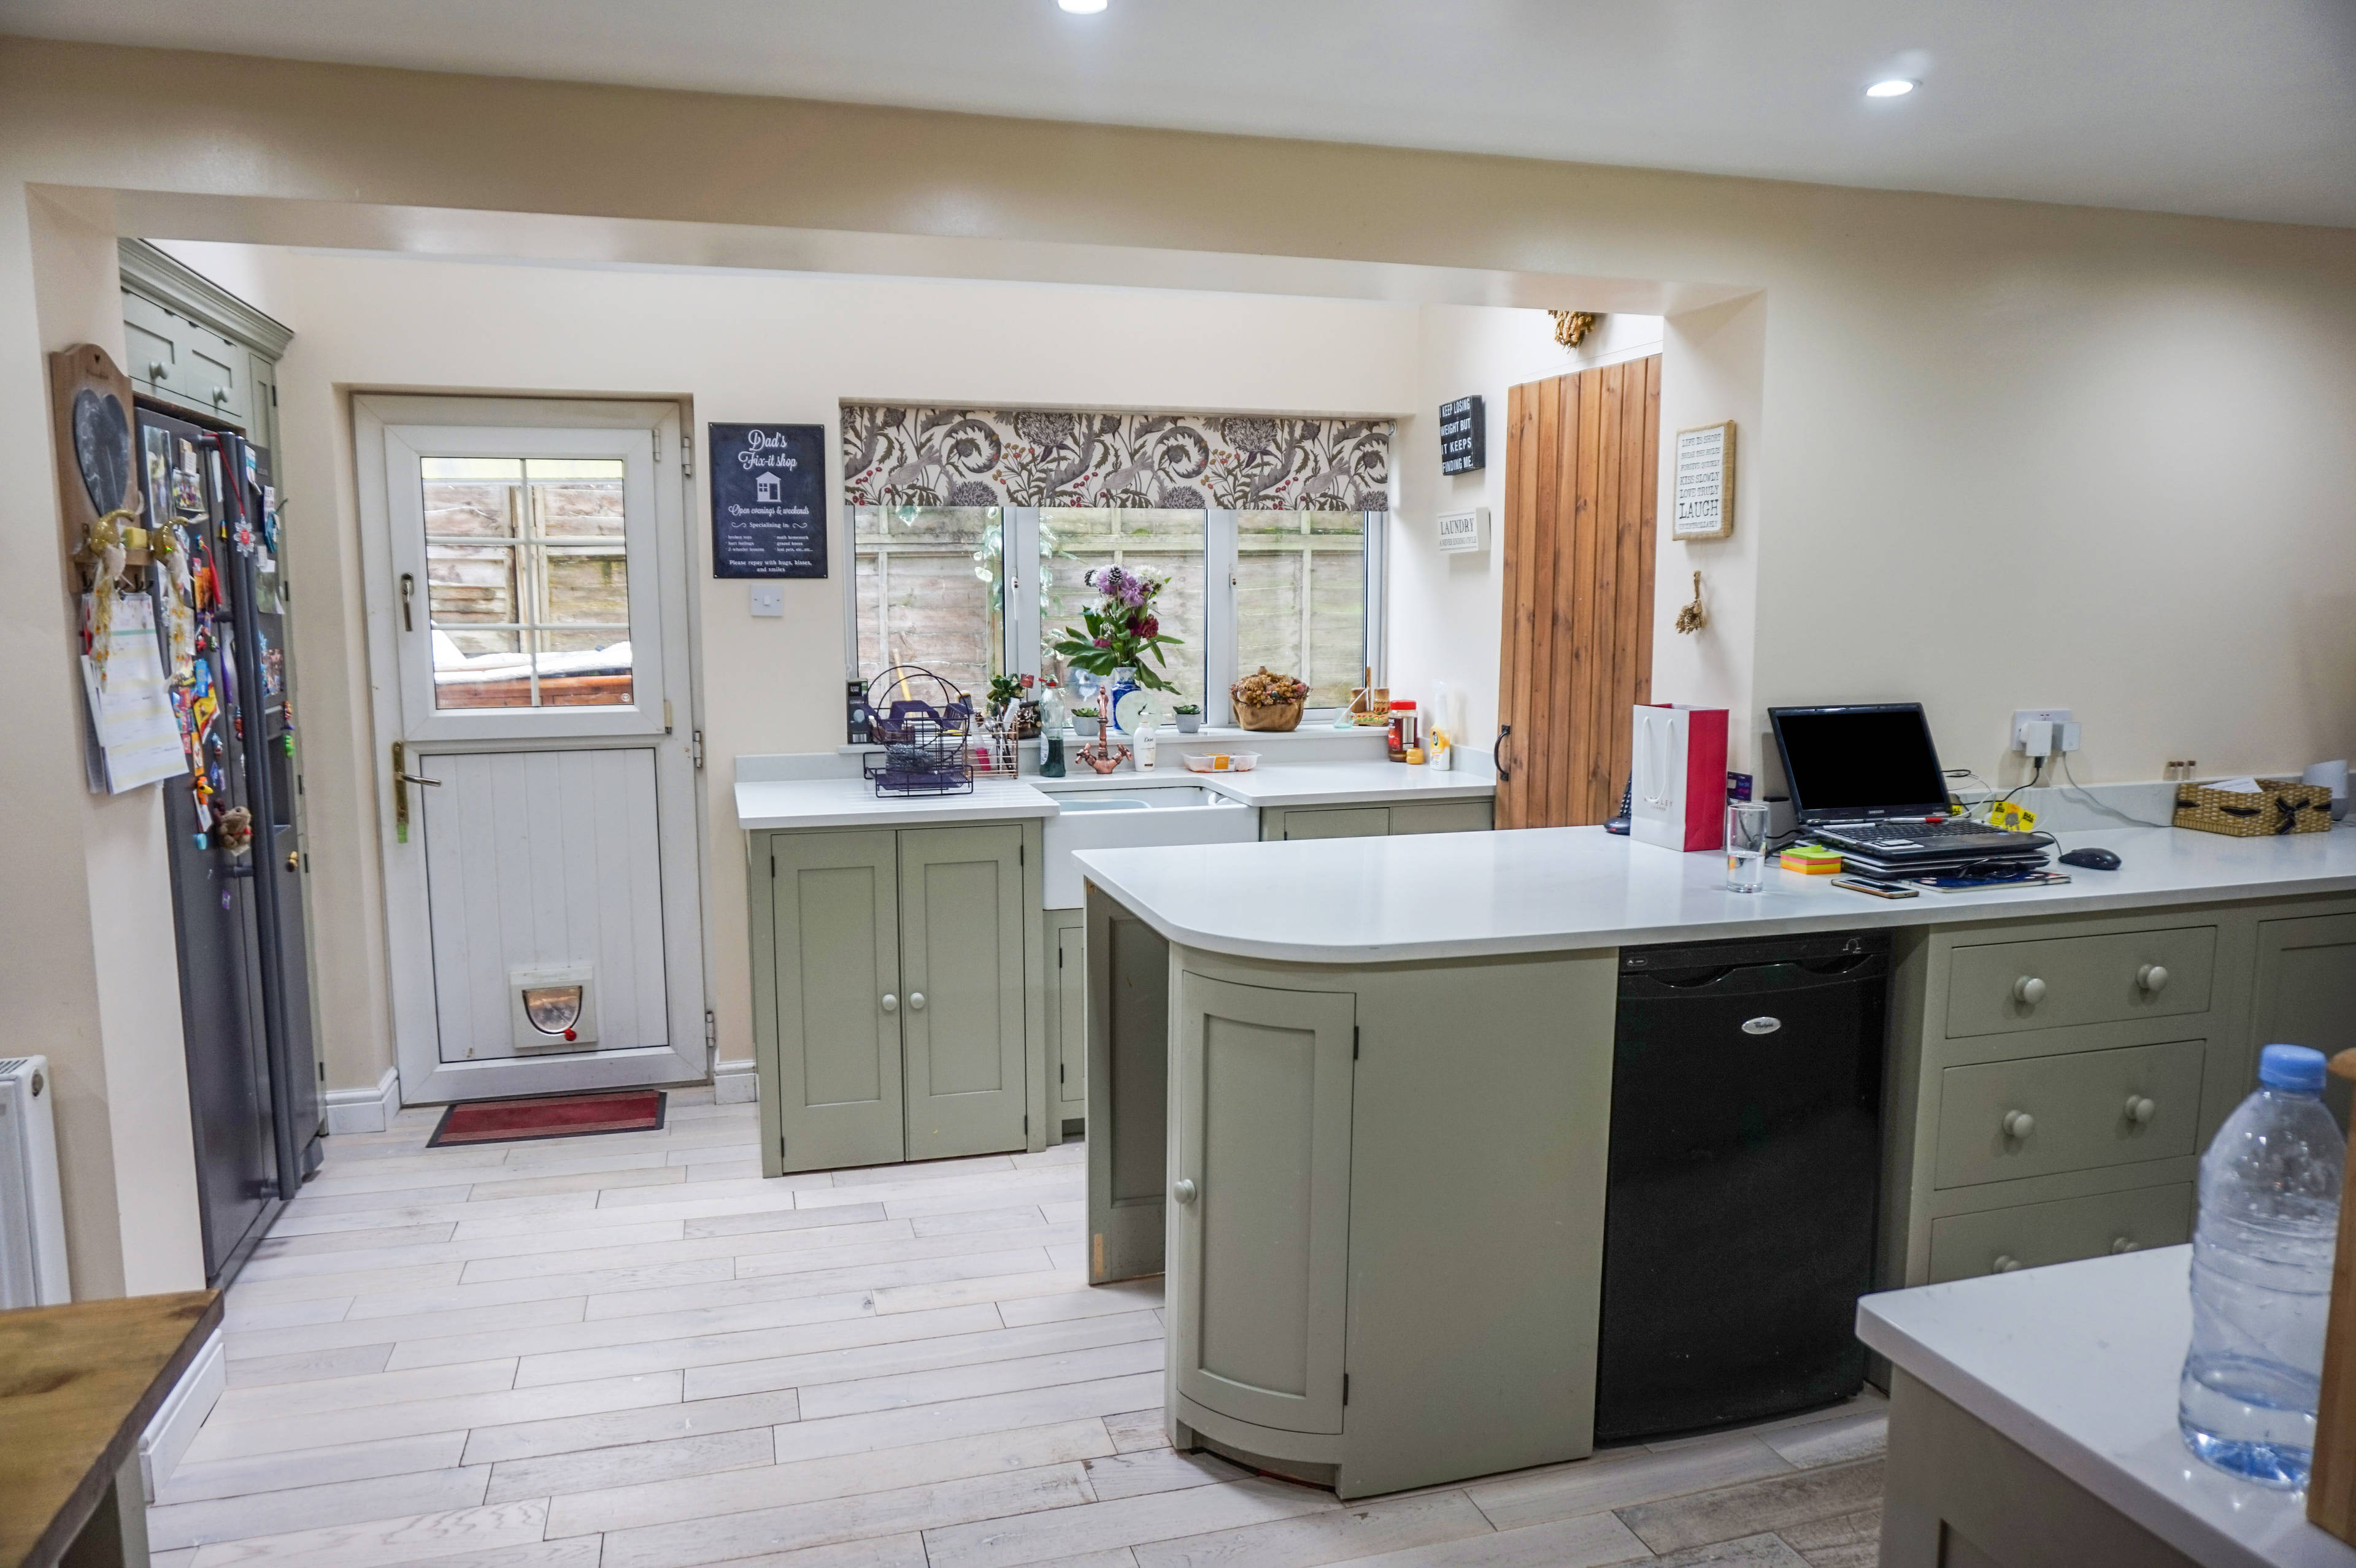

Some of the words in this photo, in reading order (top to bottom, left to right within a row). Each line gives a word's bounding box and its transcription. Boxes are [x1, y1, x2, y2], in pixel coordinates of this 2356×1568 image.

[1442, 404, 1453, 417] KEEP
[1454, 398, 1471, 414] LOSING
[1440, 421, 1460, 436] WEIGHT
[1460, 418, 1471, 431] BUT
[748, 429, 788, 451] Dad's
[1442, 444, 1448, 455] IT
[1450, 437, 1472, 453] KEEPS
[1682, 437, 1695, 447] LIFE
[1696, 436, 1703, 445] IS
[1703, 433, 1721, 443] SHORT
[738, 451, 775, 470] Fix-it
[776, 453, 798, 472] shop
[1442, 458, 1463, 473] FINDING
[1680, 475, 1695, 485] KISS
[1695, 472, 1720, 483] SLOWLY
[1679, 488, 1696, 499] LOVE
[1697, 485, 1719, 496] TRULY
[728, 504, 750, 517] Open
[751, 506, 776, 517] evenings
[776, 506, 783, 515] &
[783, 505, 810, 515] weekends
[1679, 499, 1719, 520] LAUGH
[1440, 518, 1474, 535] LAUNDRY
